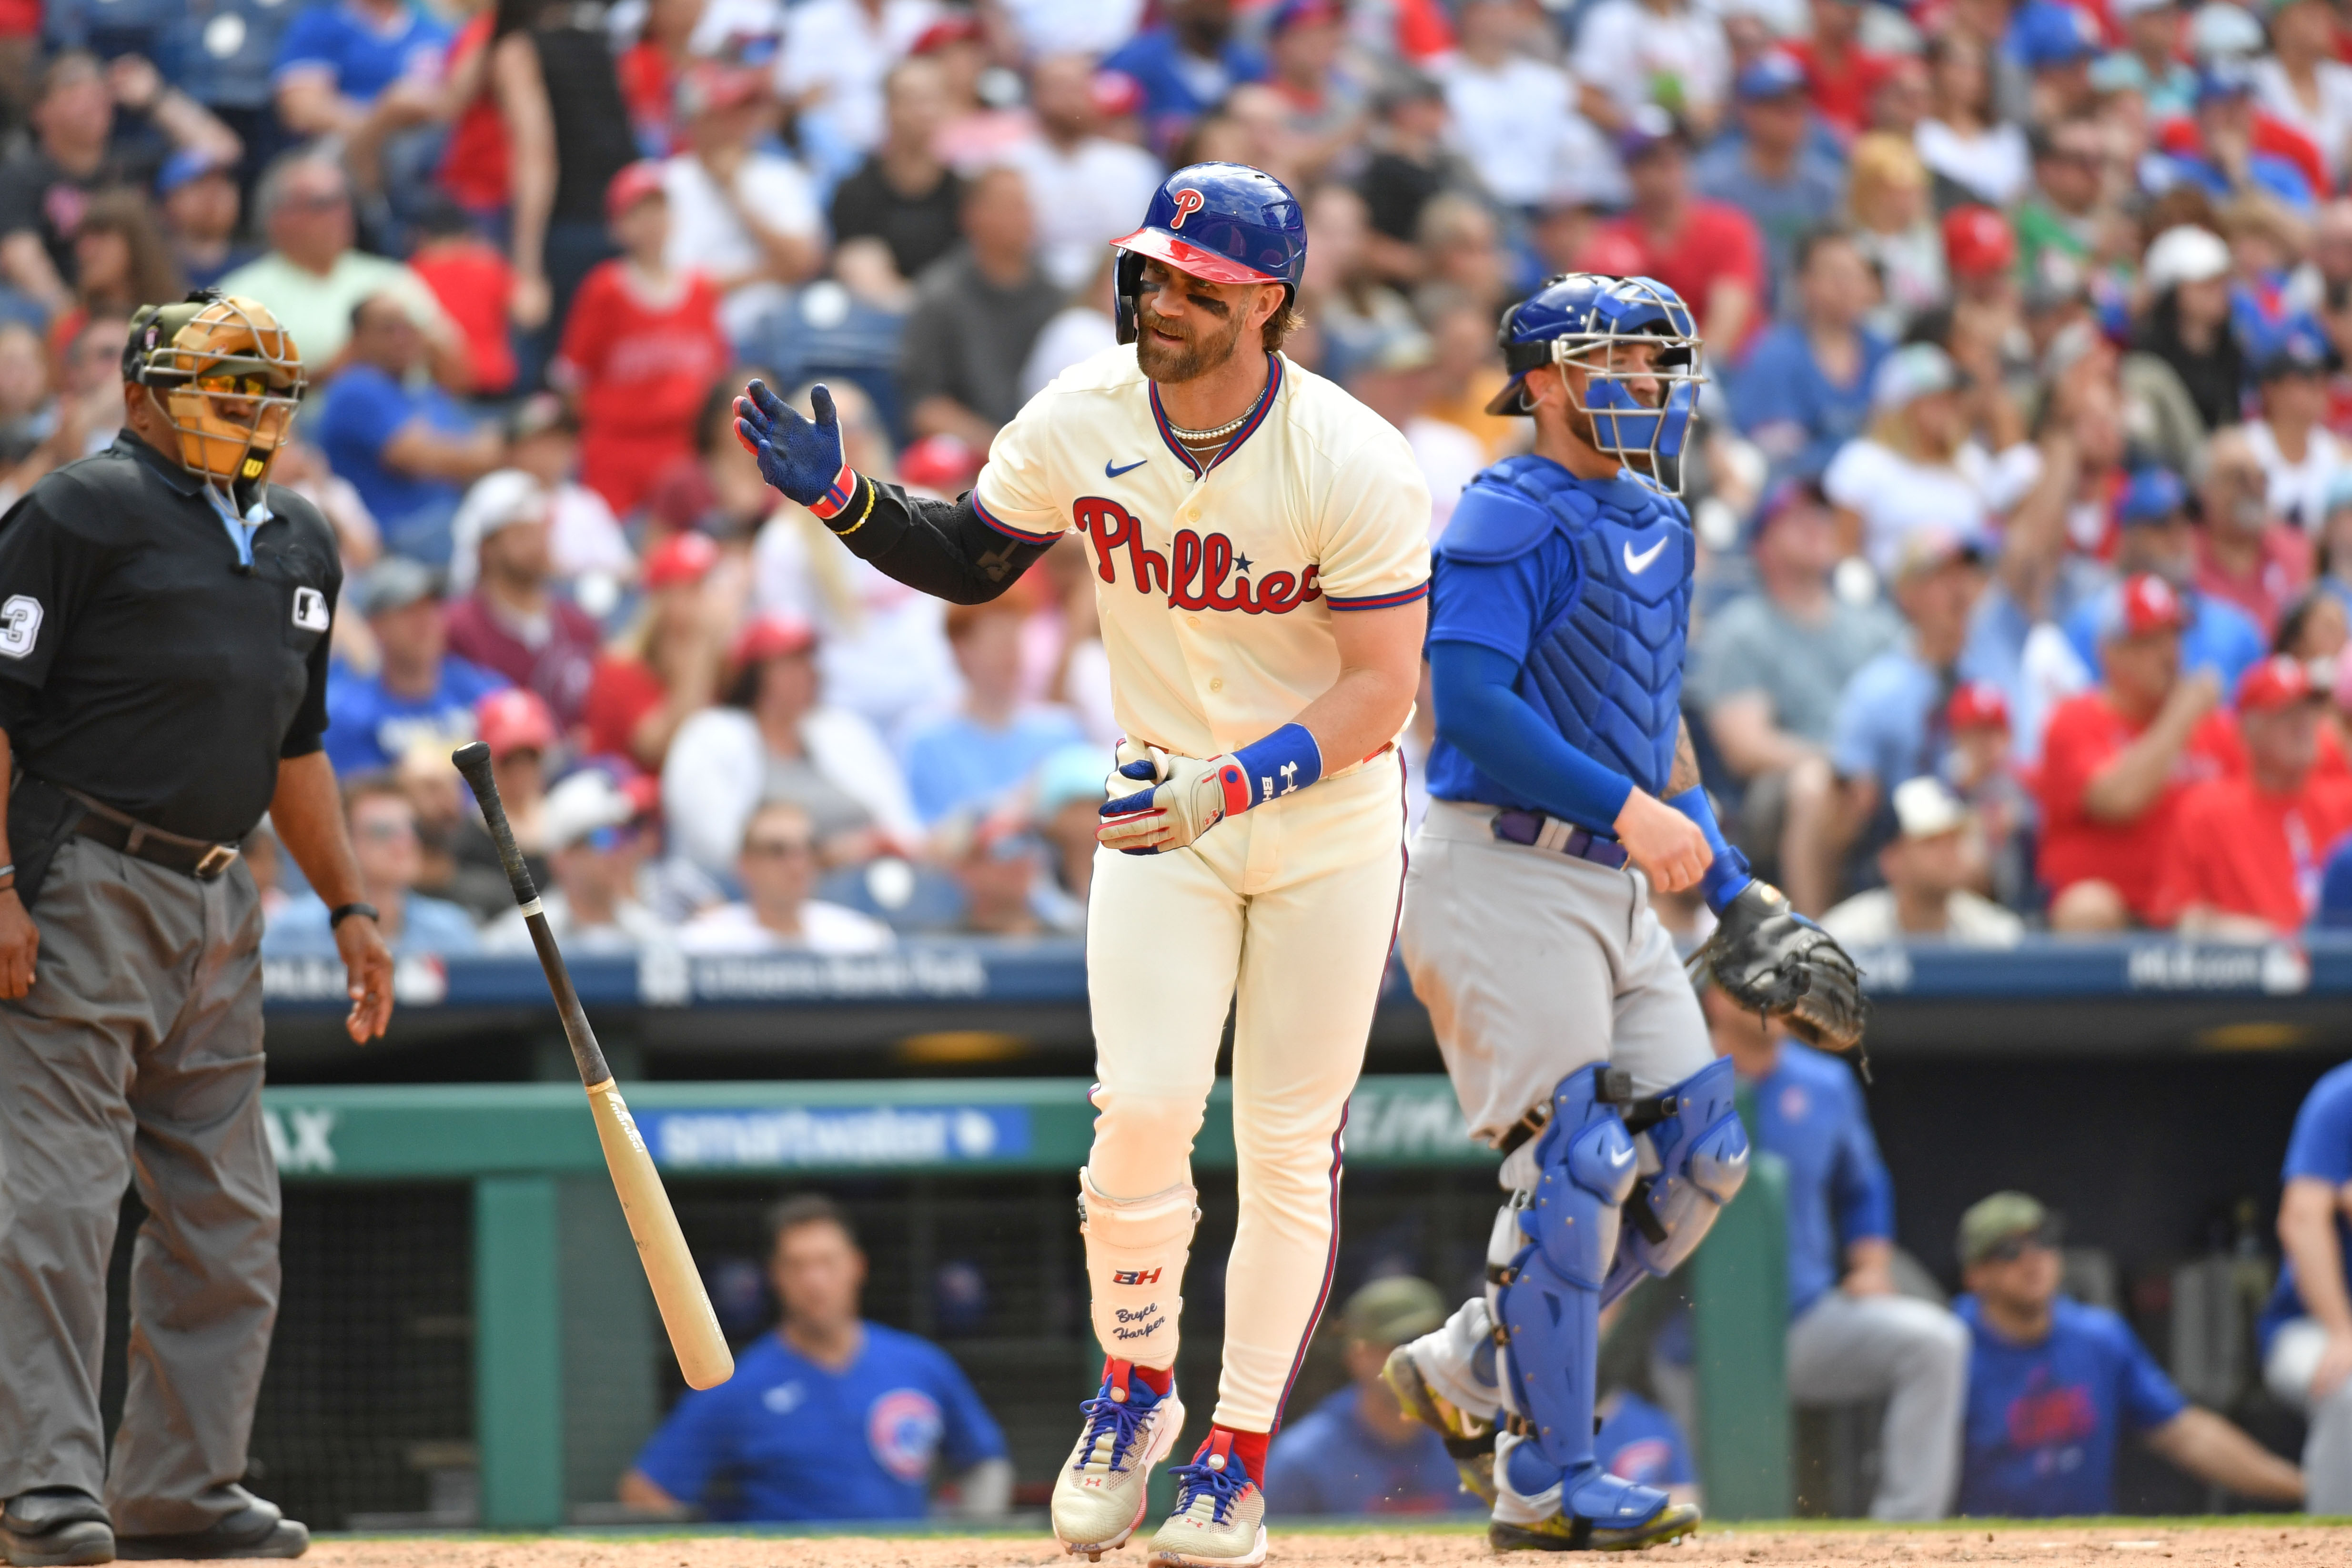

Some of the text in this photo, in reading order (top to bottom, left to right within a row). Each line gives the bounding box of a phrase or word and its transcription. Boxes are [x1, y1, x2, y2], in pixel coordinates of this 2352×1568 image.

[1170, 188, 1204, 230] P
[1072, 496, 1323, 615] Phllies
[609, 1102, 643, 1153] marucci
[1112, 1266, 1163, 1285] BH
[1112, 1315, 1166, 1340] Harper
[1115, 1302, 1158, 1323] Bryce
